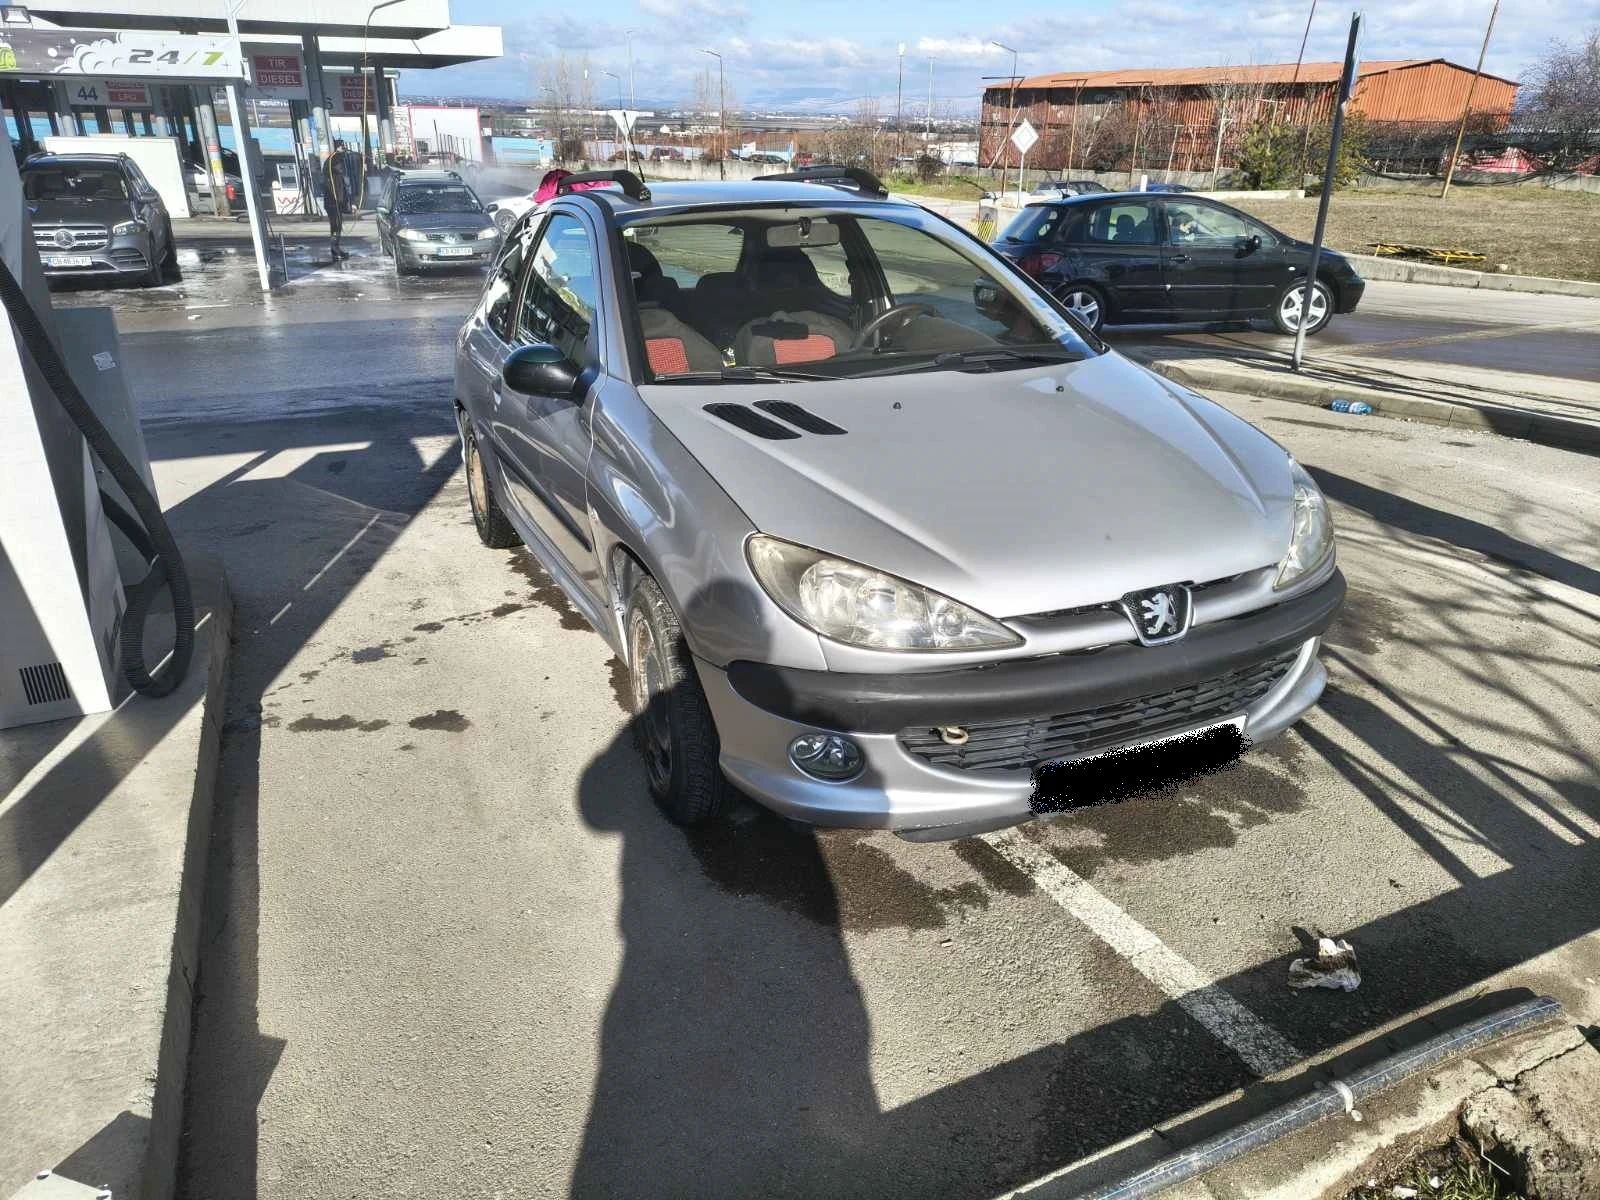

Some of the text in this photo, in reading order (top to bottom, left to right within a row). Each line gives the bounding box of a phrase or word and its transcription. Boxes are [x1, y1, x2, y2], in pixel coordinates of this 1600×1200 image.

[128, 49, 224, 66] 24/7
[268, 58, 287, 69] TIR
[260, 73, 299, 85] DIESEL
[78, 86, 98, 101] 44
